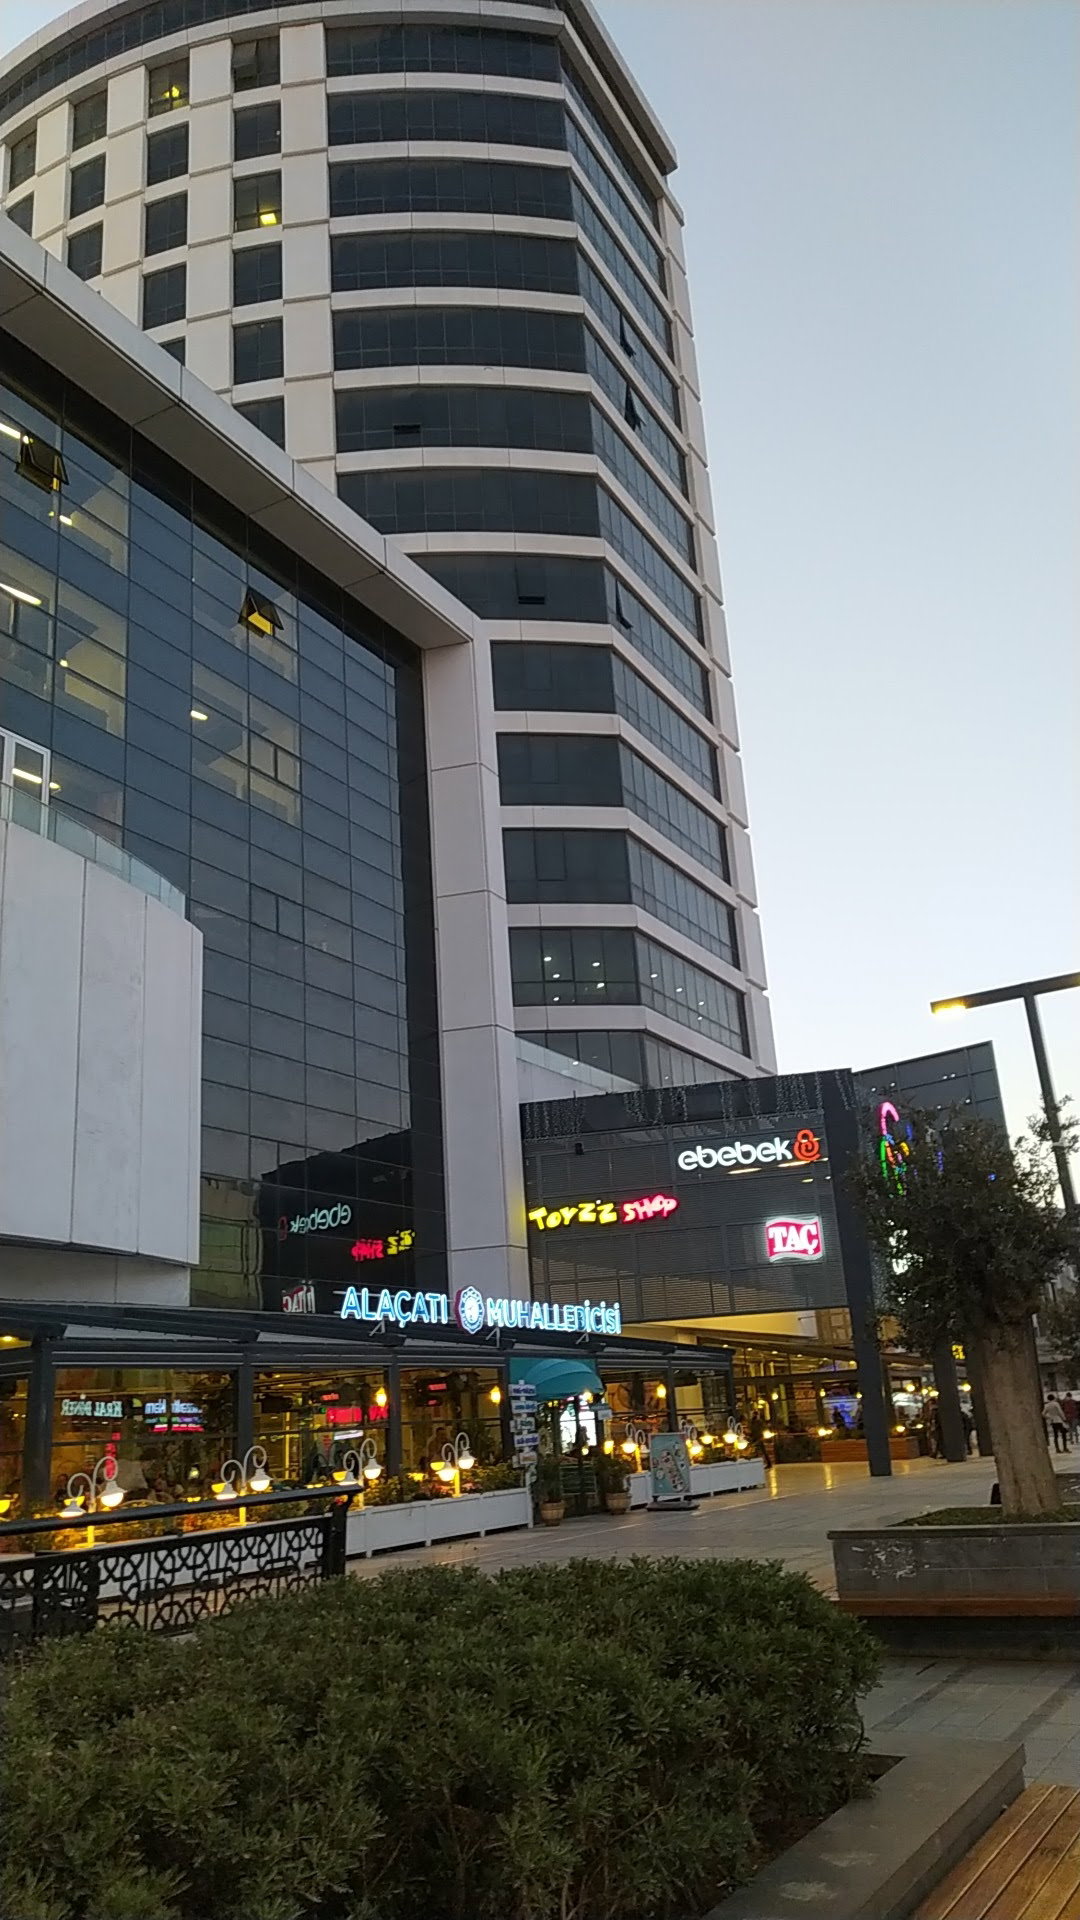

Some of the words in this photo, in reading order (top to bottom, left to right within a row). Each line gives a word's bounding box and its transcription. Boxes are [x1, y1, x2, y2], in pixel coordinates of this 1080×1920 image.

[678, 1136, 793, 1171] ebebek
[767, 1224, 818, 1255] TAÇ
[340, 1286, 449, 1329] ALAÇATI
